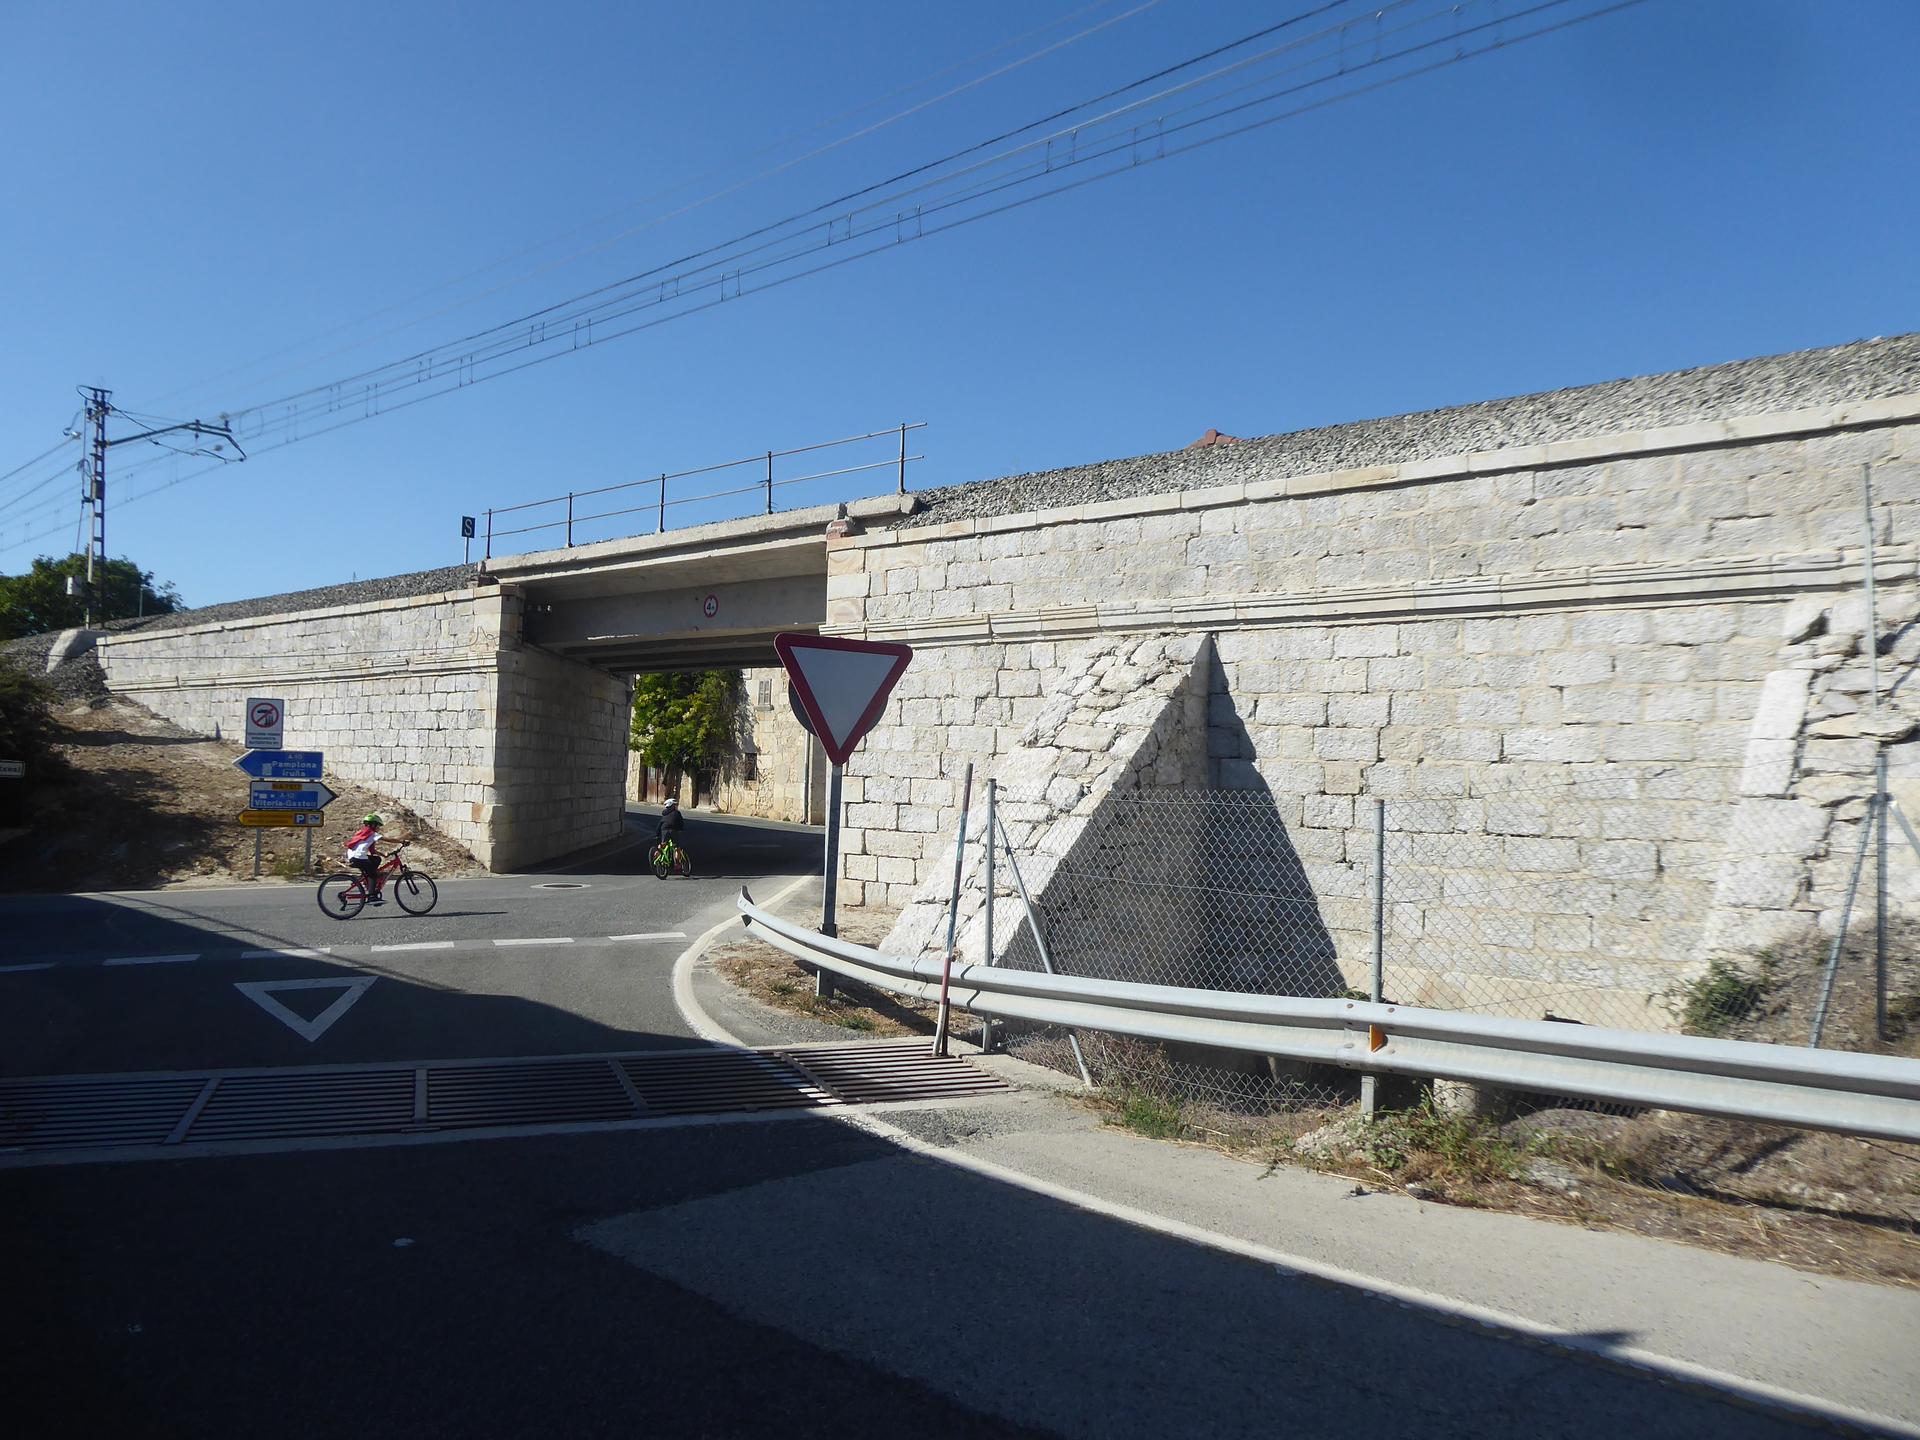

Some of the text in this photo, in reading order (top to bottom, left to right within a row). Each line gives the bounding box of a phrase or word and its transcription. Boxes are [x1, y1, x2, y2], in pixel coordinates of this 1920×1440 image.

[464, 518, 472, 536] S
[272, 760, 318, 768] Pamplona
[296, 815, 305, 824] P
